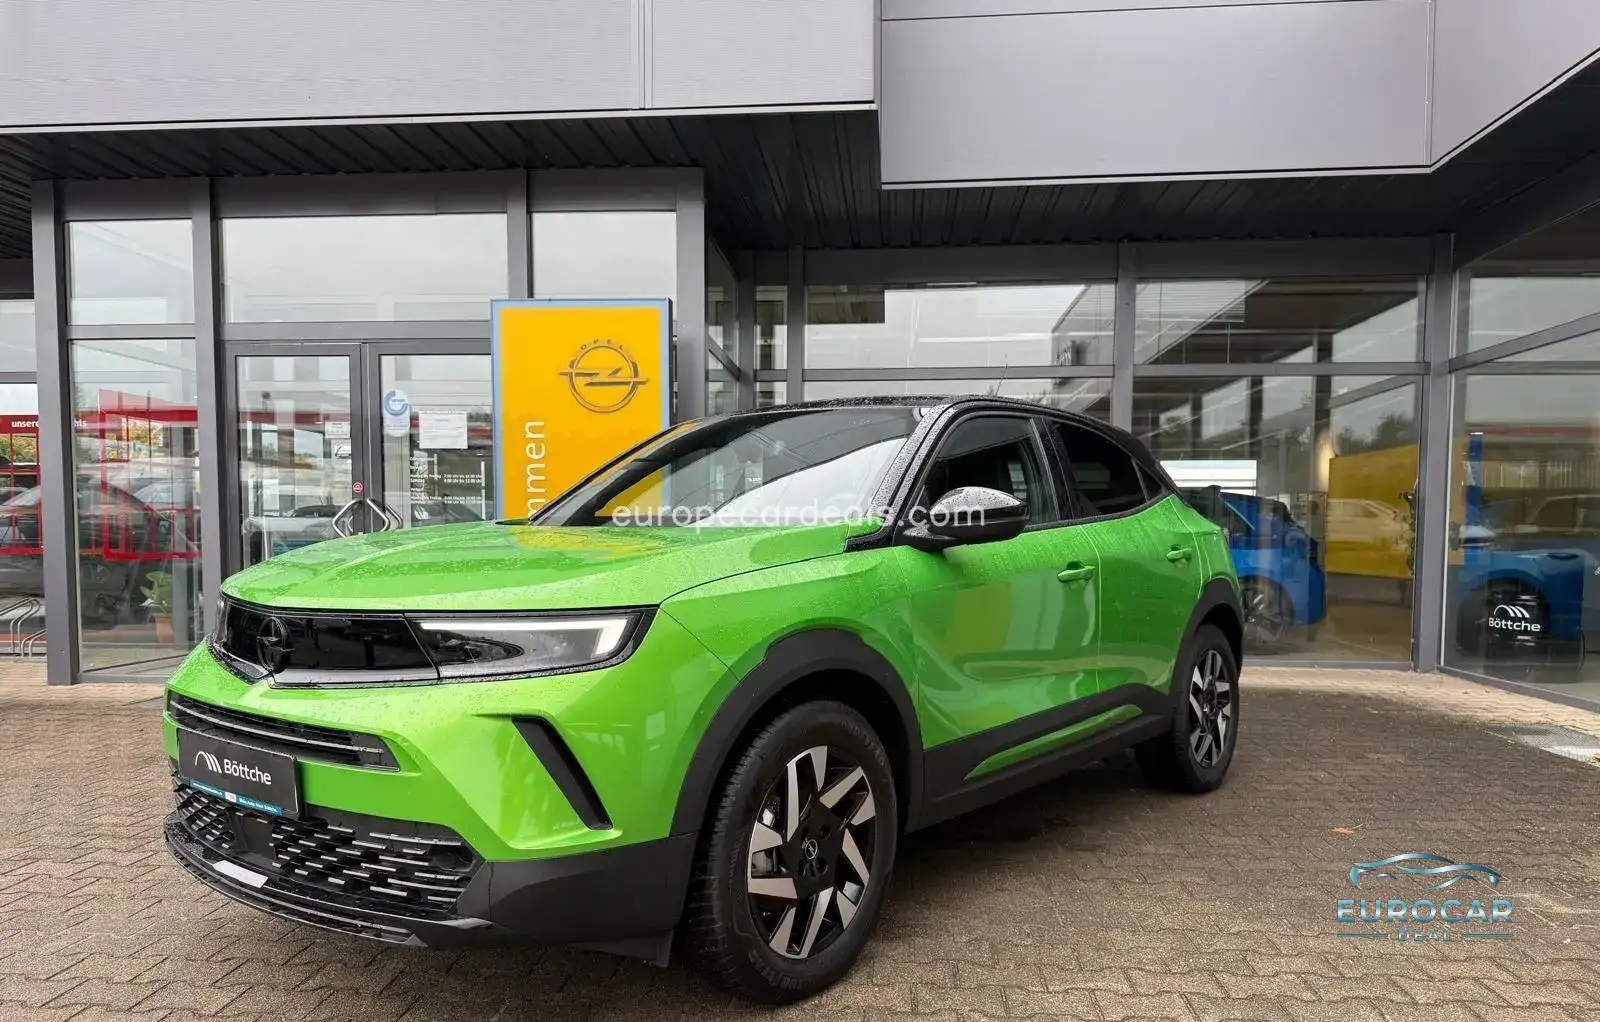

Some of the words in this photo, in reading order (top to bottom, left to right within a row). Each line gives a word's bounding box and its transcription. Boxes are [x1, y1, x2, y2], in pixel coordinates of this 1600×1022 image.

[580, 338, 625, 351] OPEL
[1488, 617, 1541, 632] Böttche
[223, 758, 272, 785] Böttche
